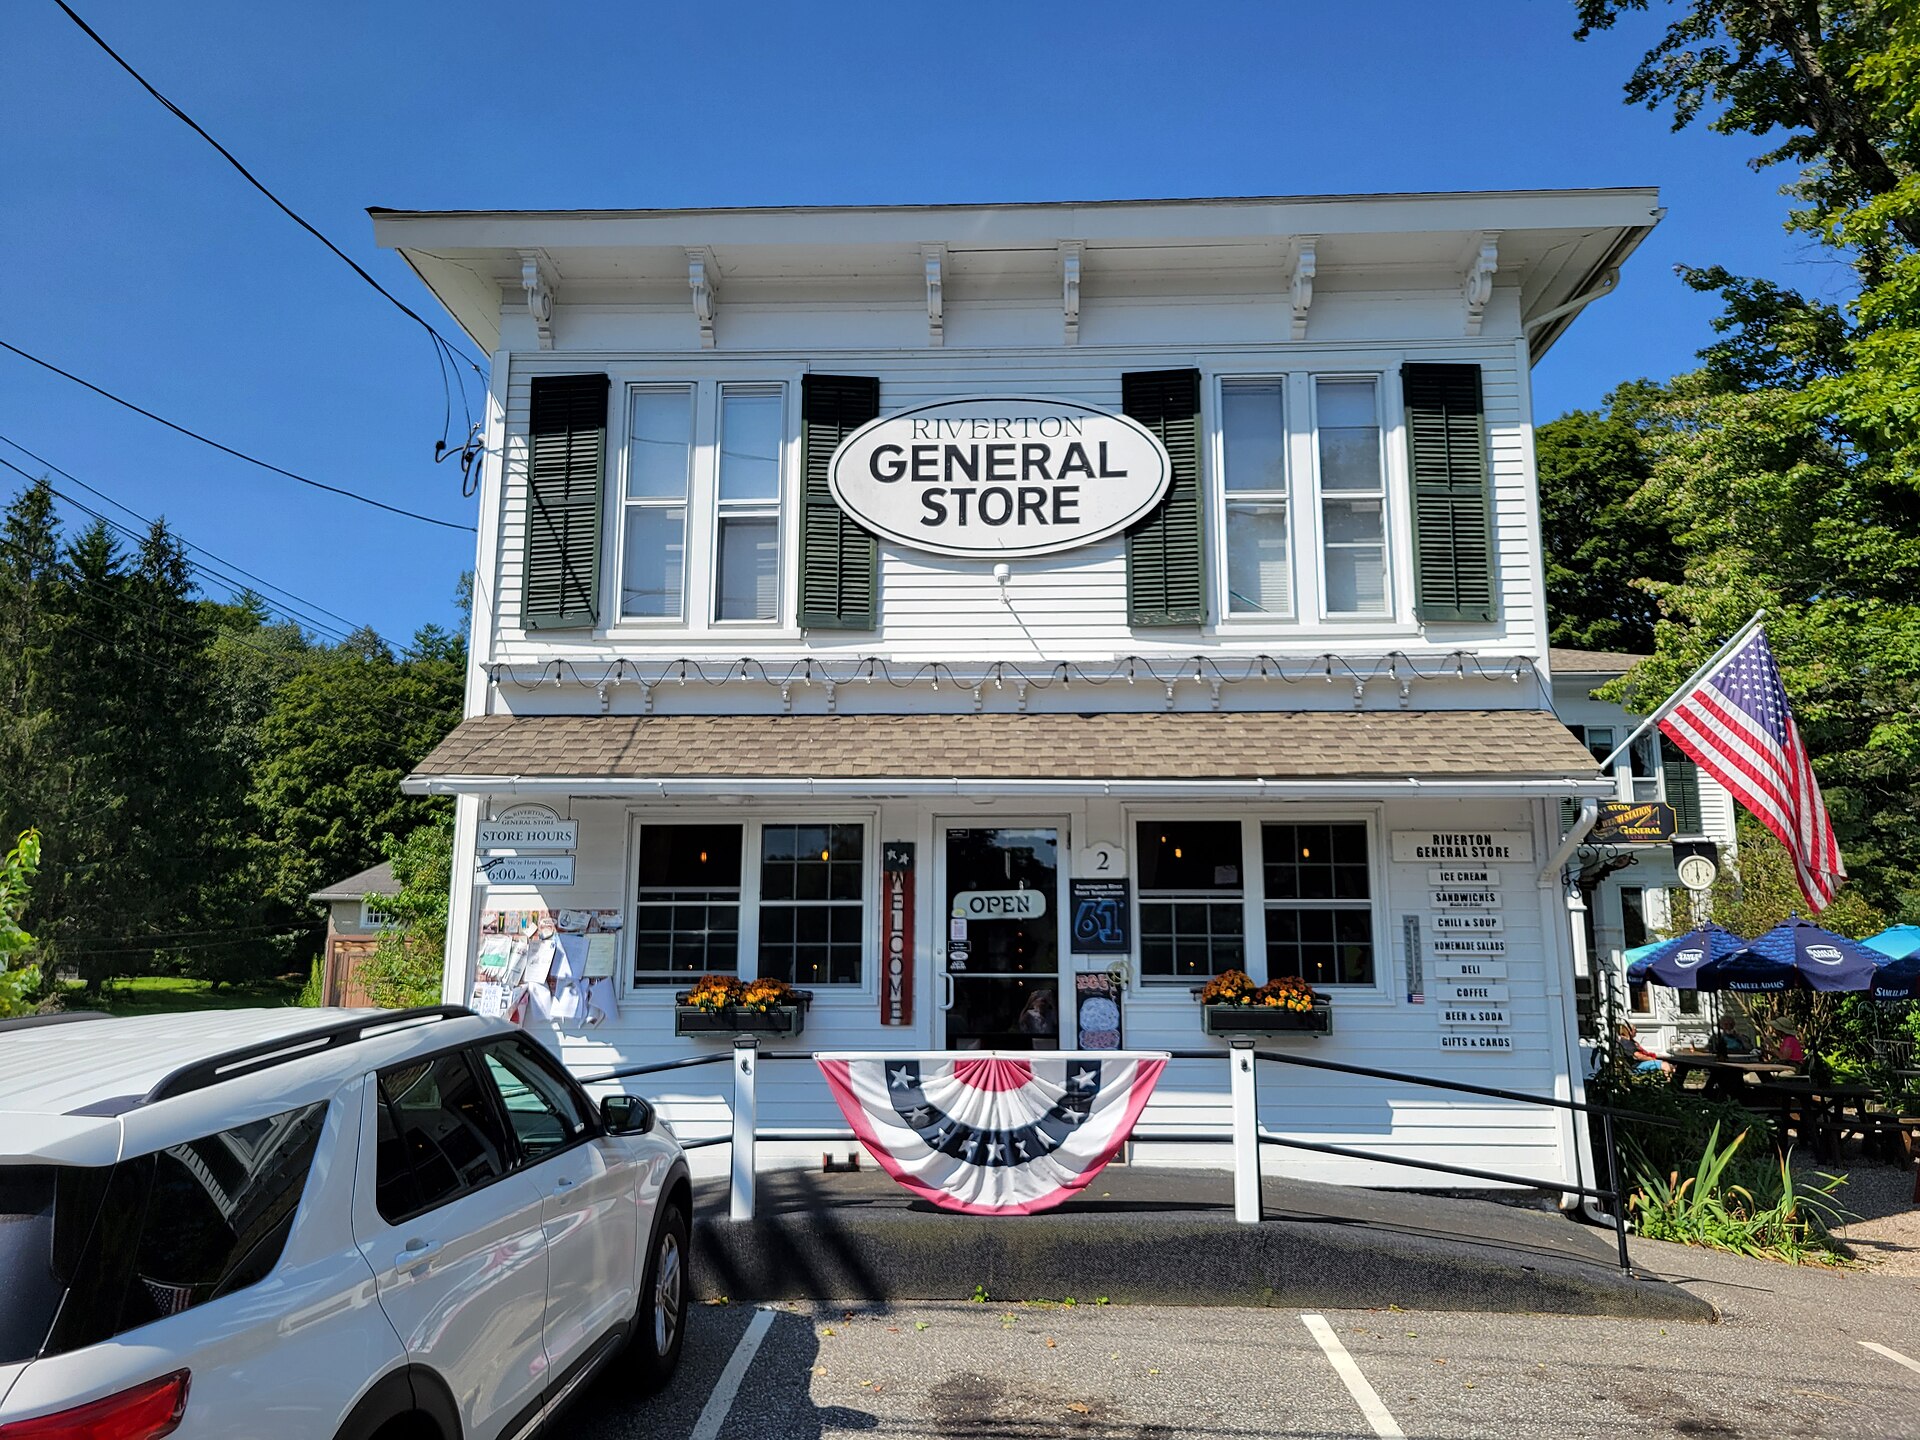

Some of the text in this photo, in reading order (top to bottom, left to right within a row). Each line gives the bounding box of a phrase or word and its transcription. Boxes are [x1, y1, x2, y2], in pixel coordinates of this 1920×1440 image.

[911, 415, 1086, 440] RIVERTON
[869, 441, 1128, 483] GENERAL
[920, 485, 1080, 527] STORE
[513, 809, 545, 818] RIVERTON
[1624, 805, 1652, 823] STATION
[1618, 825, 1662, 835] GENERAL
[482, 831, 572, 841] STORE HOURS
[1432, 834, 1492, 846] RIVERTON
[1416, 846, 1510, 858] GENERAL STORE
[1096, 851, 1110, 870] 2
[1440, 872, 1488, 881] ICE CREAM
[1435, 892, 1496, 902] SANDWICHES
[970, 895, 1030, 913] OPEN
[1438, 918, 1462, 928] CHILI
[1473, 918, 1497, 927] SOUP
[889, 872, 904, 1025] WELCOME
[1434, 941, 1505, 951] HOMEMADE SALADS
[1461, 965, 1480, 974] DELI
[1729, 980, 1785, 990] SAMUEL ADAMS
[1457, 988, 1489, 998] COFFEE
[1445, 1011, 1503, 1021] BEER & SODA
[1442, 1037, 1510, 1048] GIFTS & CARDS
